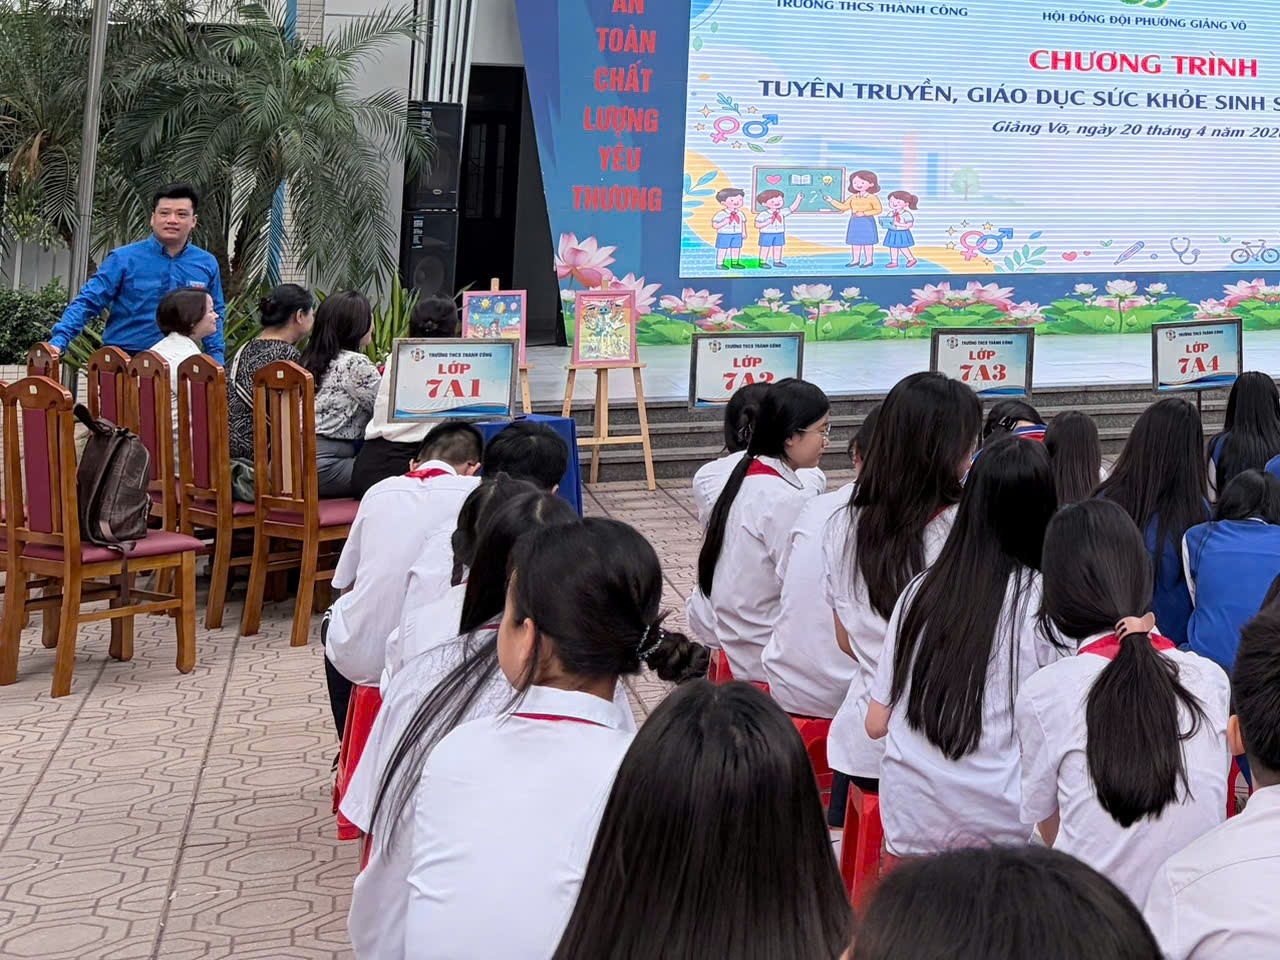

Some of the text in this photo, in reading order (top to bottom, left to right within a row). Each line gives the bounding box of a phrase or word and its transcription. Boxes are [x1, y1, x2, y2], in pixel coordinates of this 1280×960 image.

[838, 1, 874, 12] THCS
[878, 2, 925, 14] THÀNH
[930, 4, 968, 17] CÔNG
[1042, 10, 1064, 23] HỘI
[1109, 13, 1130, 27] ĐỘI
[1135, 16, 1186, 28] PHƯỜNG
[1190, 17, 1228, 30] GIẢNG
[1231, 19, 1247, 30] VÕ
[596, 24, 657, 54] TOÀN
[1029, 50, 1257, 77] CHƯƠNG TRÌNH
[594, 60, 654, 93] CHẤT
[758, 77, 843, 99] TUYÊN
[852, 78, 958, 103] TRUYỀN,
[967, 84, 1027, 104] GIÁO
[1036, 89, 1085, 109] DỤC
[1092, 87, 1138, 108] SỨC
[1146, 88, 1207, 109] KHỎE
[1215, 95, 1265, 111] SINH
[583, 104, 659, 136] LƯỢNG
[991, 120, 1042, 137] Giảng
[1076, 123, 1117, 137] ngày
[1120, 123, 1142, 135] 20
[1146, 124, 1191, 138] tháng
[1196, 125, 1207, 137] 4
[1211, 126, 1245, 138] năm
[599, 142, 642, 172] YÊU
[572, 185, 662, 212] THƯƠNG
[969, 348, 996, 360] LỚP
[1186, 341, 1209, 353] LỚP
[438, 360, 471, 374] LỚP
[733, 355, 762, 368] LỚP
[1178, 355, 1219, 374] 7A4
[960, 364, 1006, 381] 7A3
[426, 379, 481, 398] 7A1
